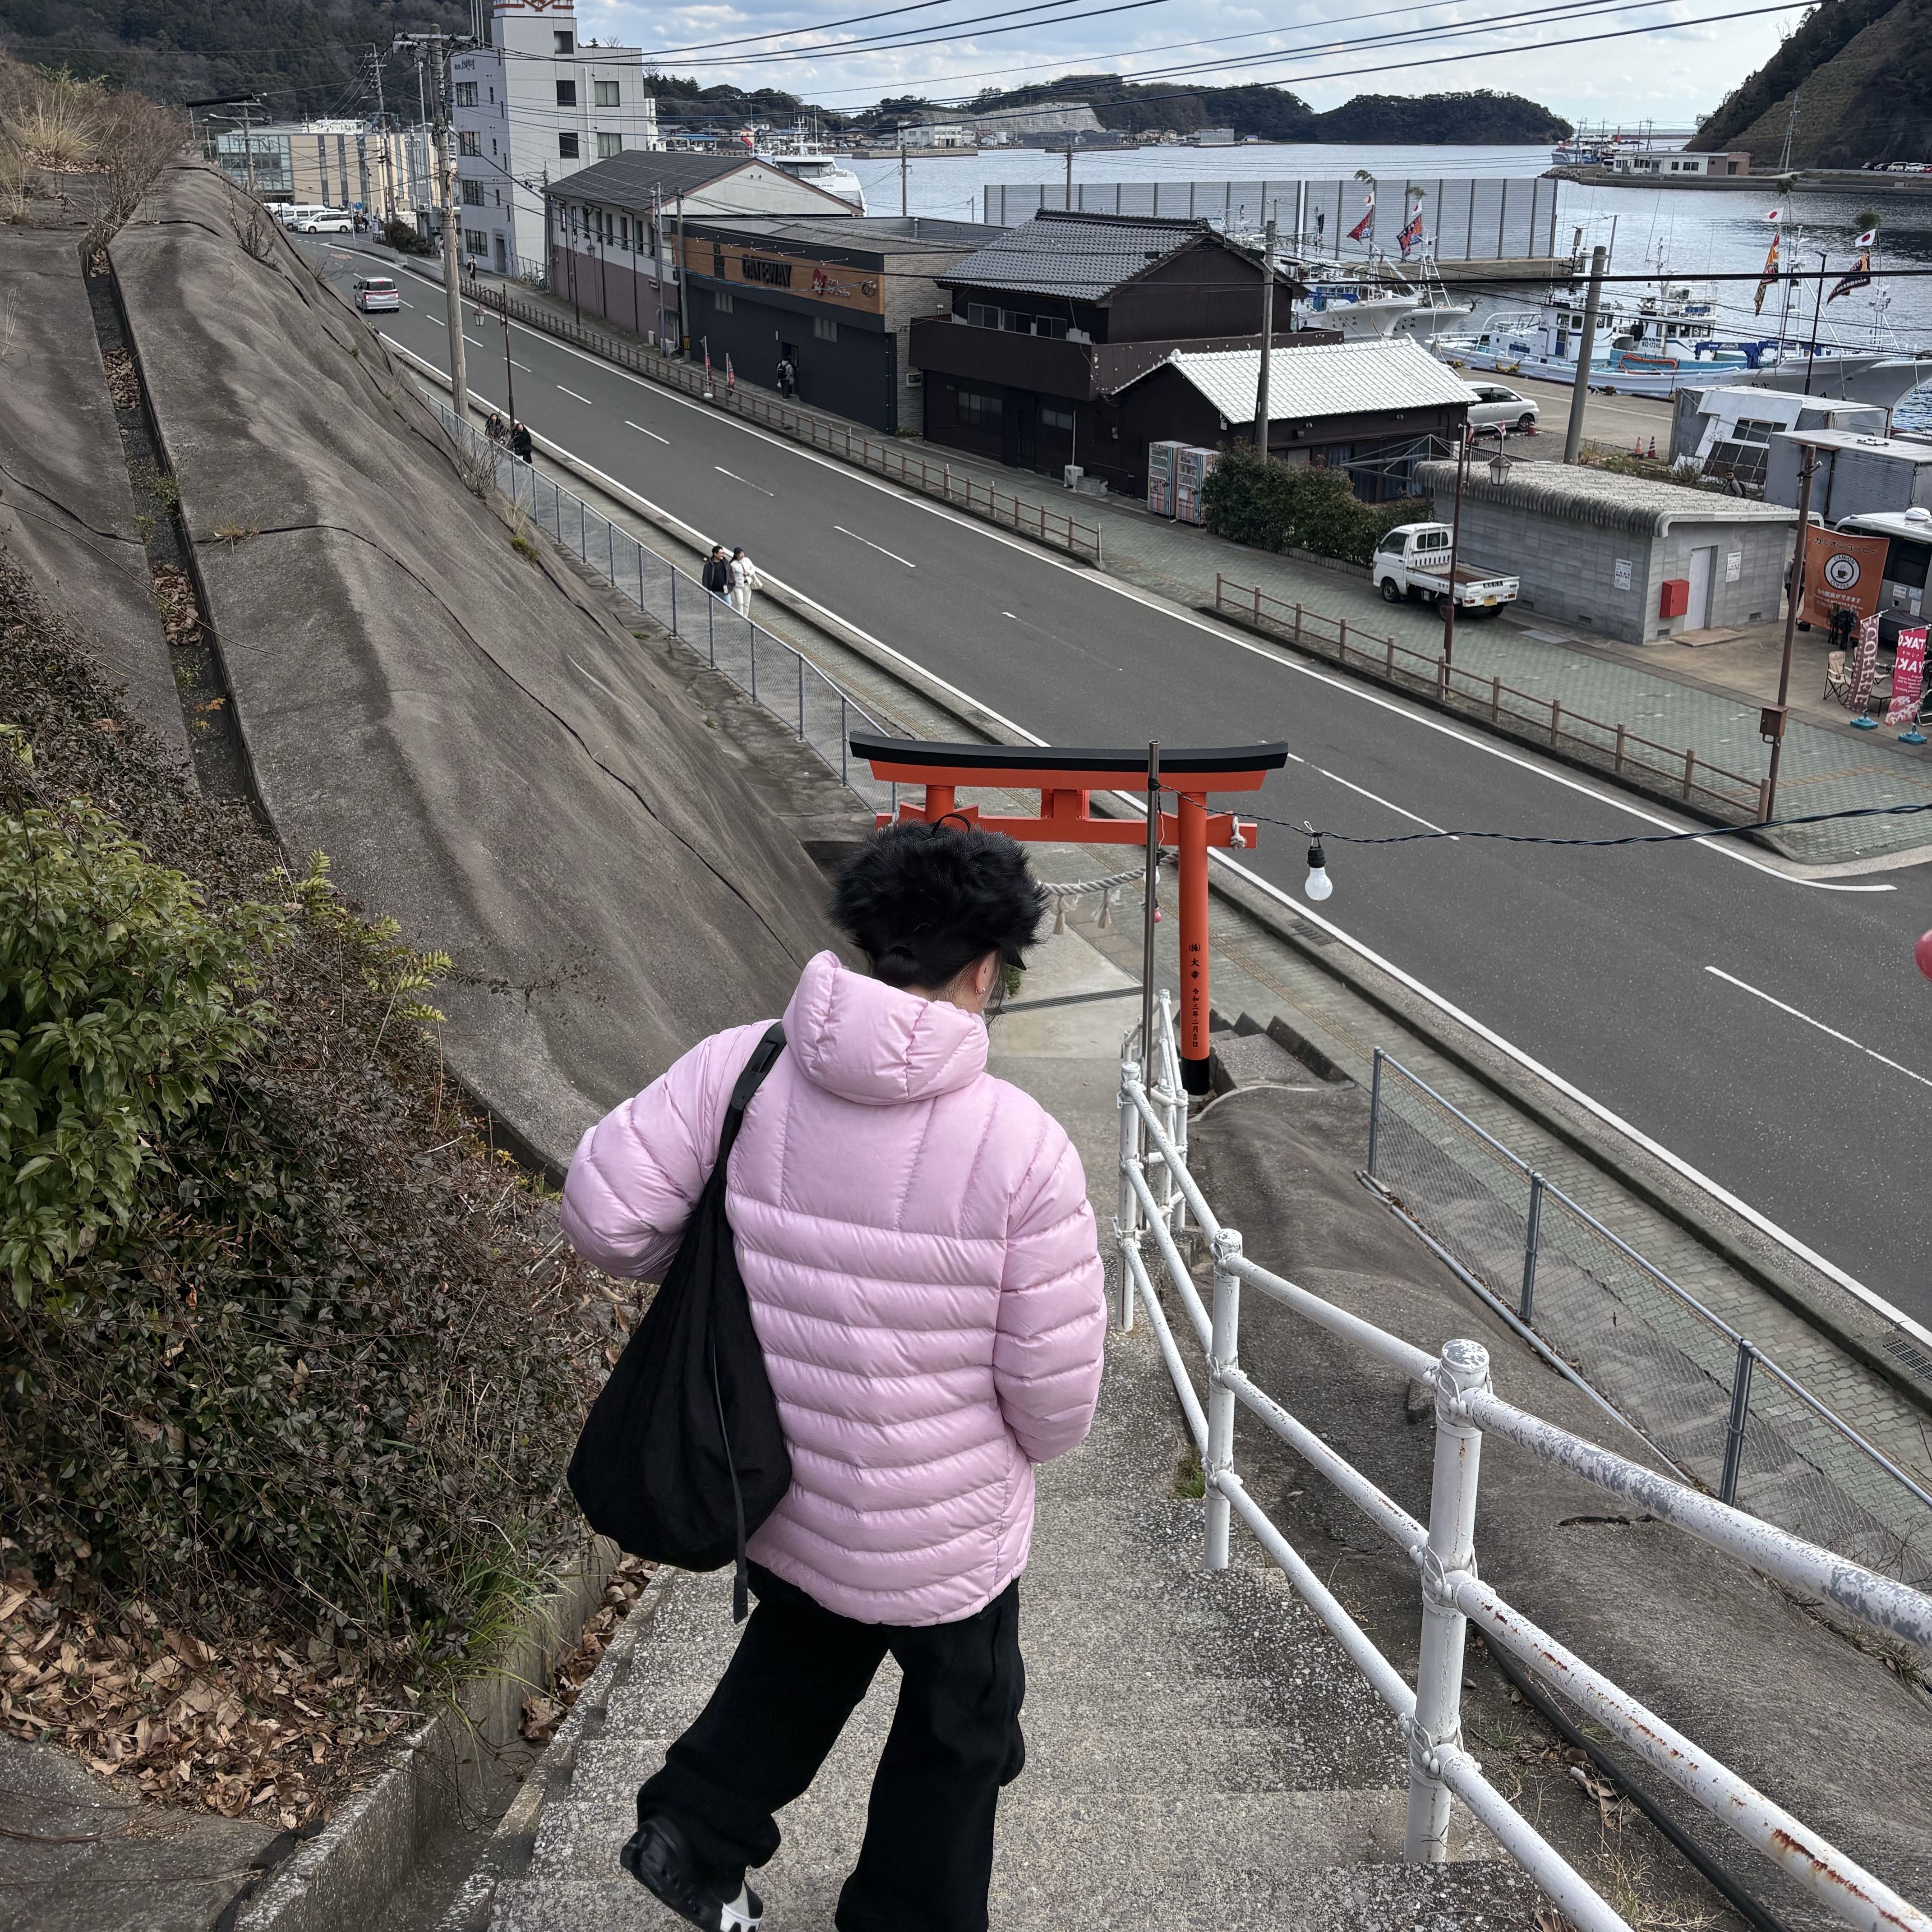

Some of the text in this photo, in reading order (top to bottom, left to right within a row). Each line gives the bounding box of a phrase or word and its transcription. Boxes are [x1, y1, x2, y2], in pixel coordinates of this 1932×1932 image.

[742, 254, 792, 288] GATEWAY
[1814, 537, 1878, 554] カミオンコーヒー
[1834, 554, 1855, 565] CAMION
[1191, 988, 1200, 1047] 令和三年二月吉日
